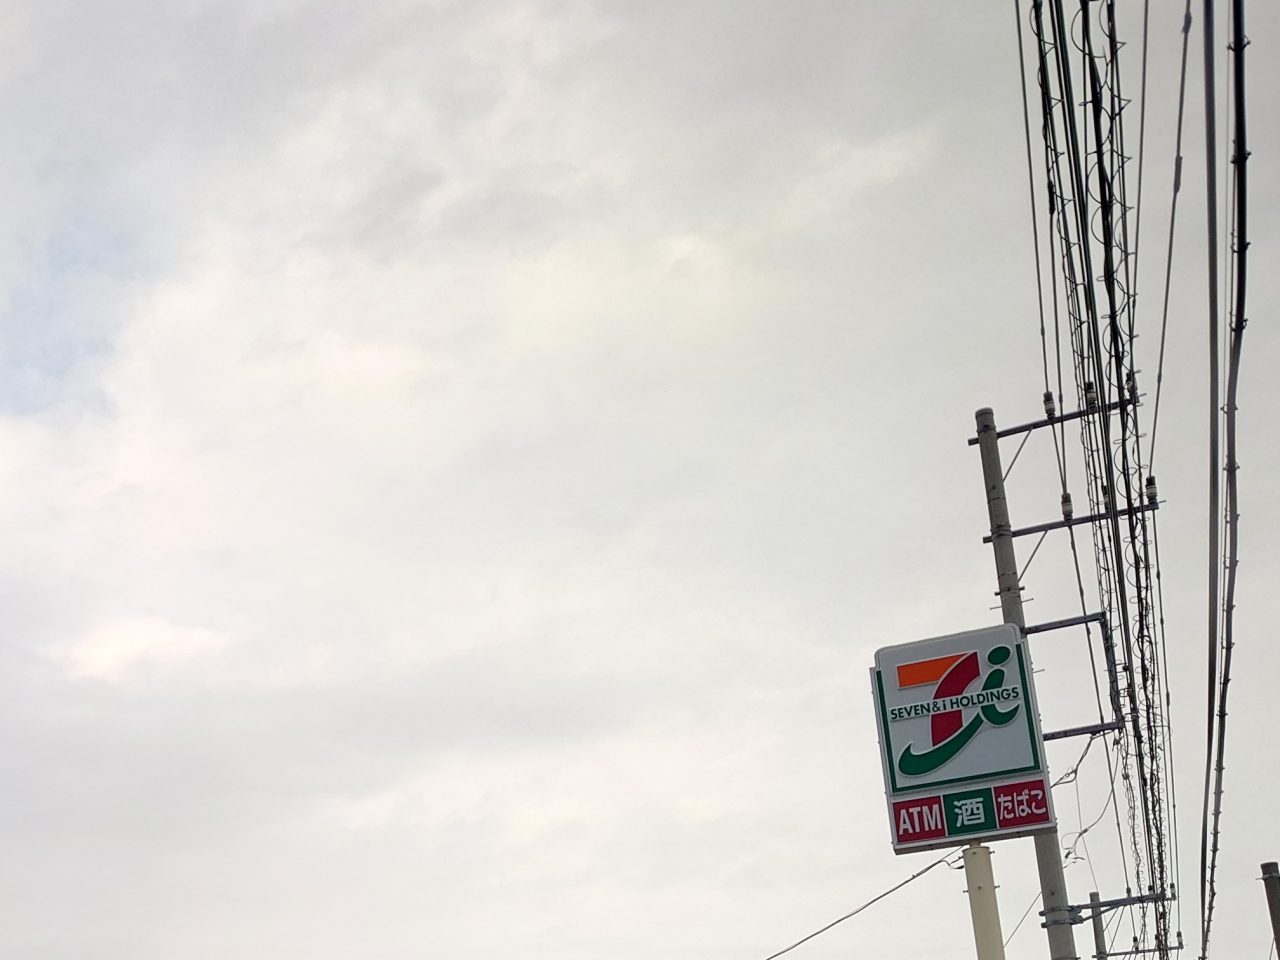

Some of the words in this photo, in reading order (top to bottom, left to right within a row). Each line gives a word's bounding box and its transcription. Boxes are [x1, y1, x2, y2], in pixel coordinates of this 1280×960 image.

[950, 687, 1019, 709] HOLDINGS
[898, 804, 942, 835] ATM
[954, 797, 985, 827] 酒
[998, 789, 1047, 821] たばこ
